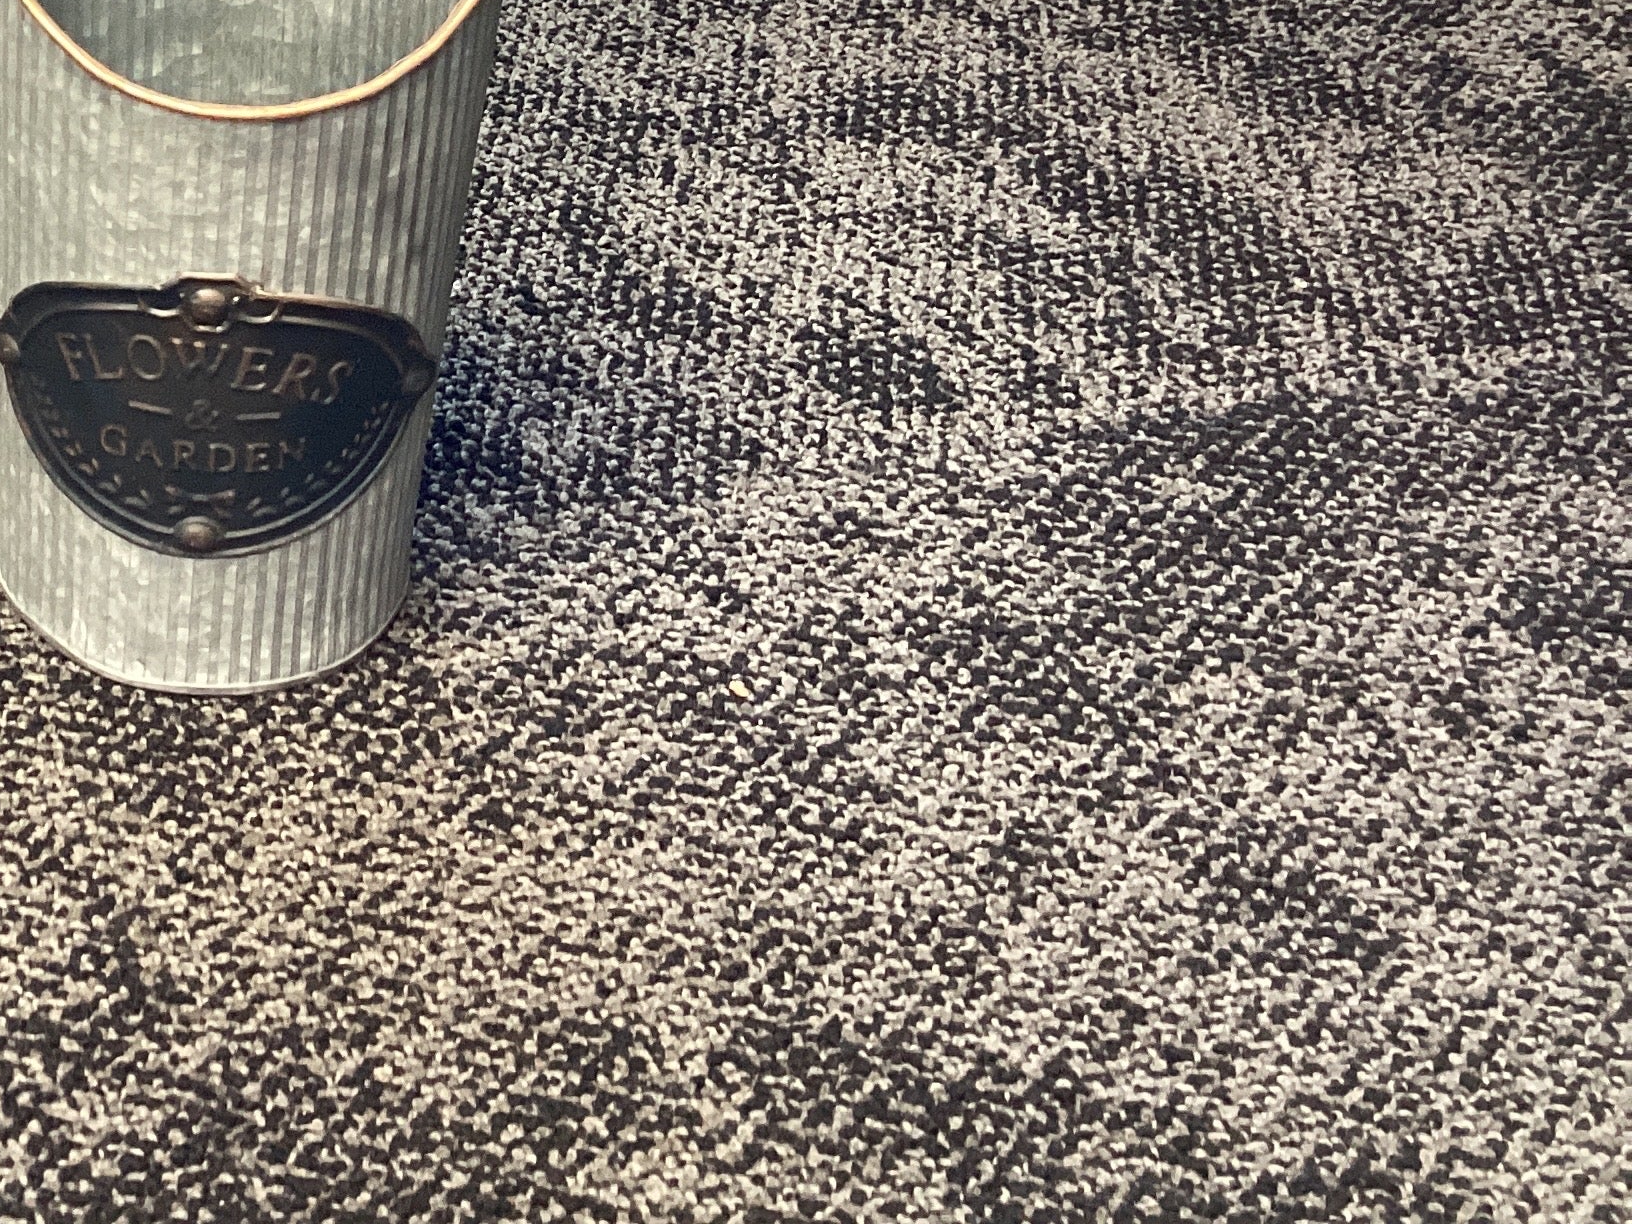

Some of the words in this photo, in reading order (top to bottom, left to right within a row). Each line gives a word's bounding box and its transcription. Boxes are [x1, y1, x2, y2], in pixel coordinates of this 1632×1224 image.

[55, 331, 355, 406] FLOWERS
[183, 399, 225, 432] &
[99, 424, 307, 474] GARDEN
